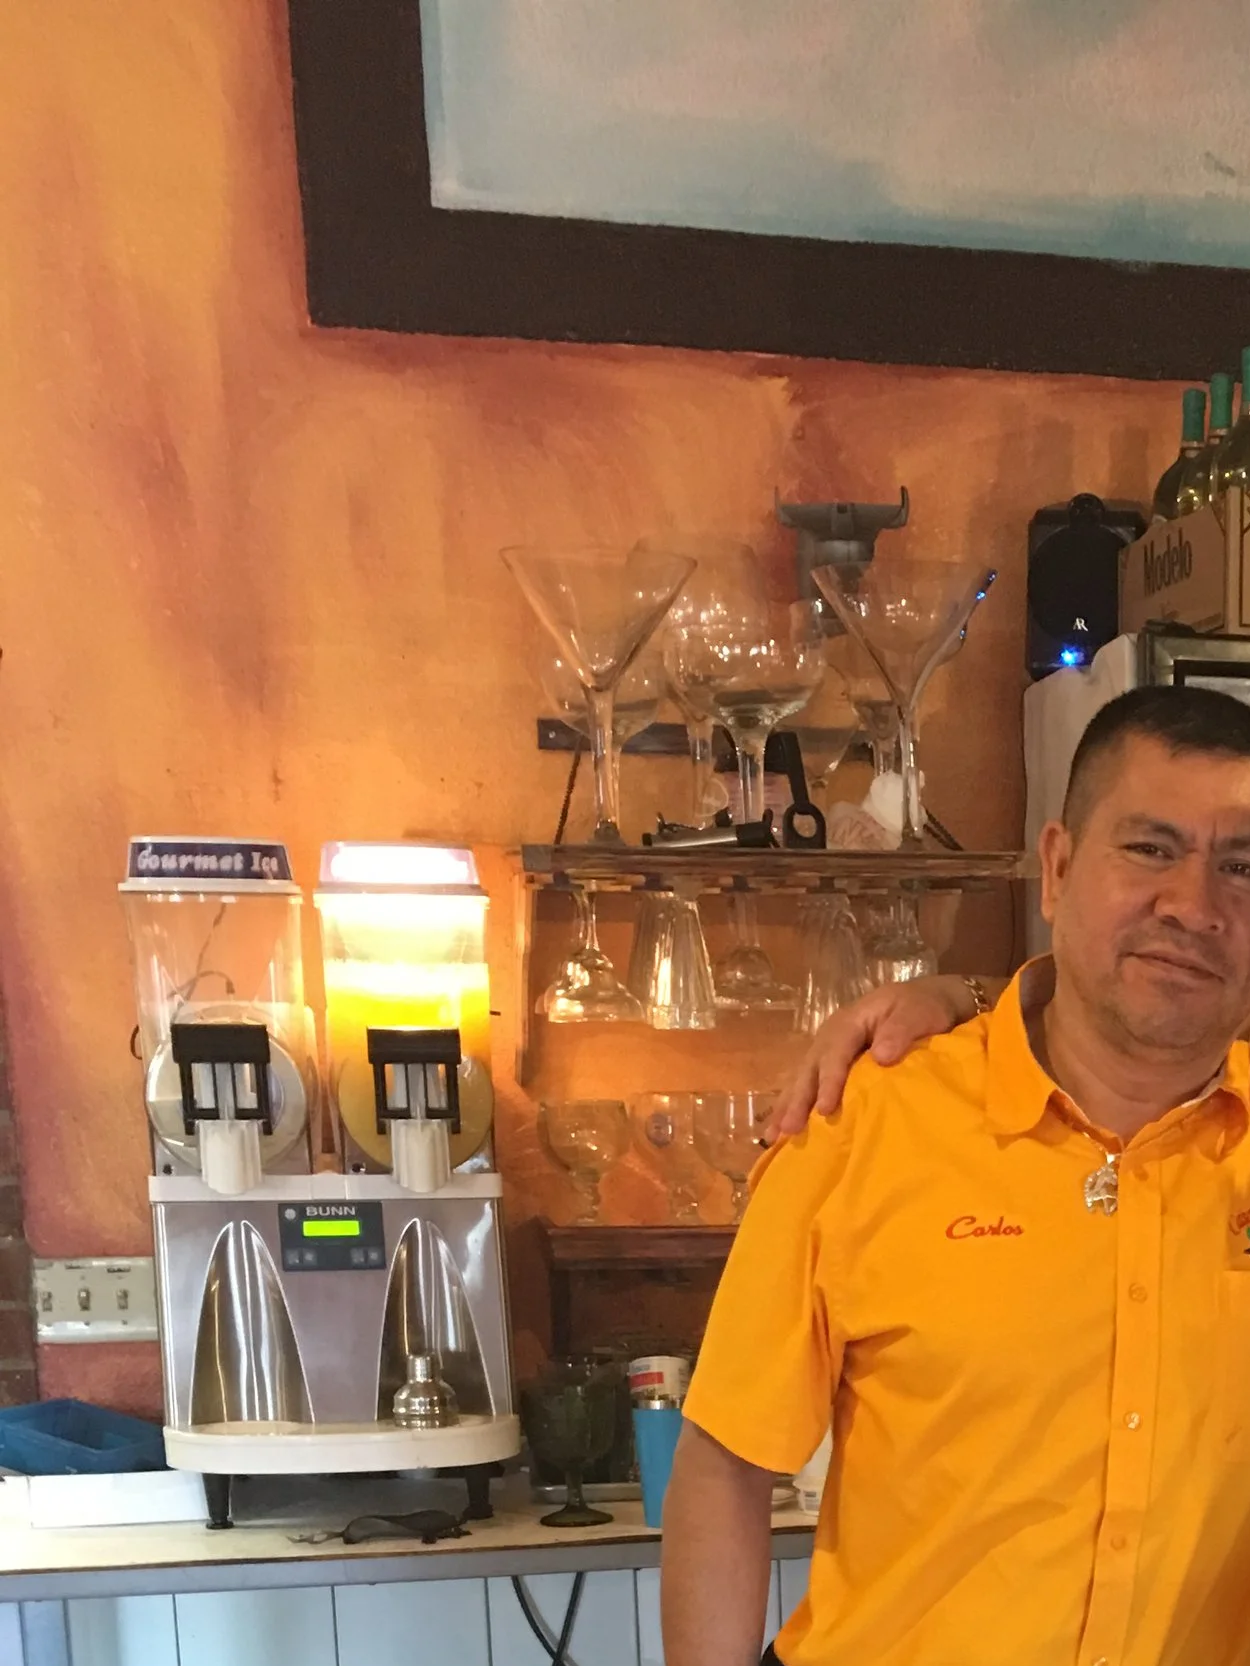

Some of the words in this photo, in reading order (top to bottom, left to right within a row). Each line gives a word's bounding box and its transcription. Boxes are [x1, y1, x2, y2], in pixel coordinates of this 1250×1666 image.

[1144, 526, 1193, 598] Modelo
[137, 843, 244, 872] Gourmet
[305, 1205, 356, 1217] BUNN
[945, 1215, 1025, 1240] Carlos
